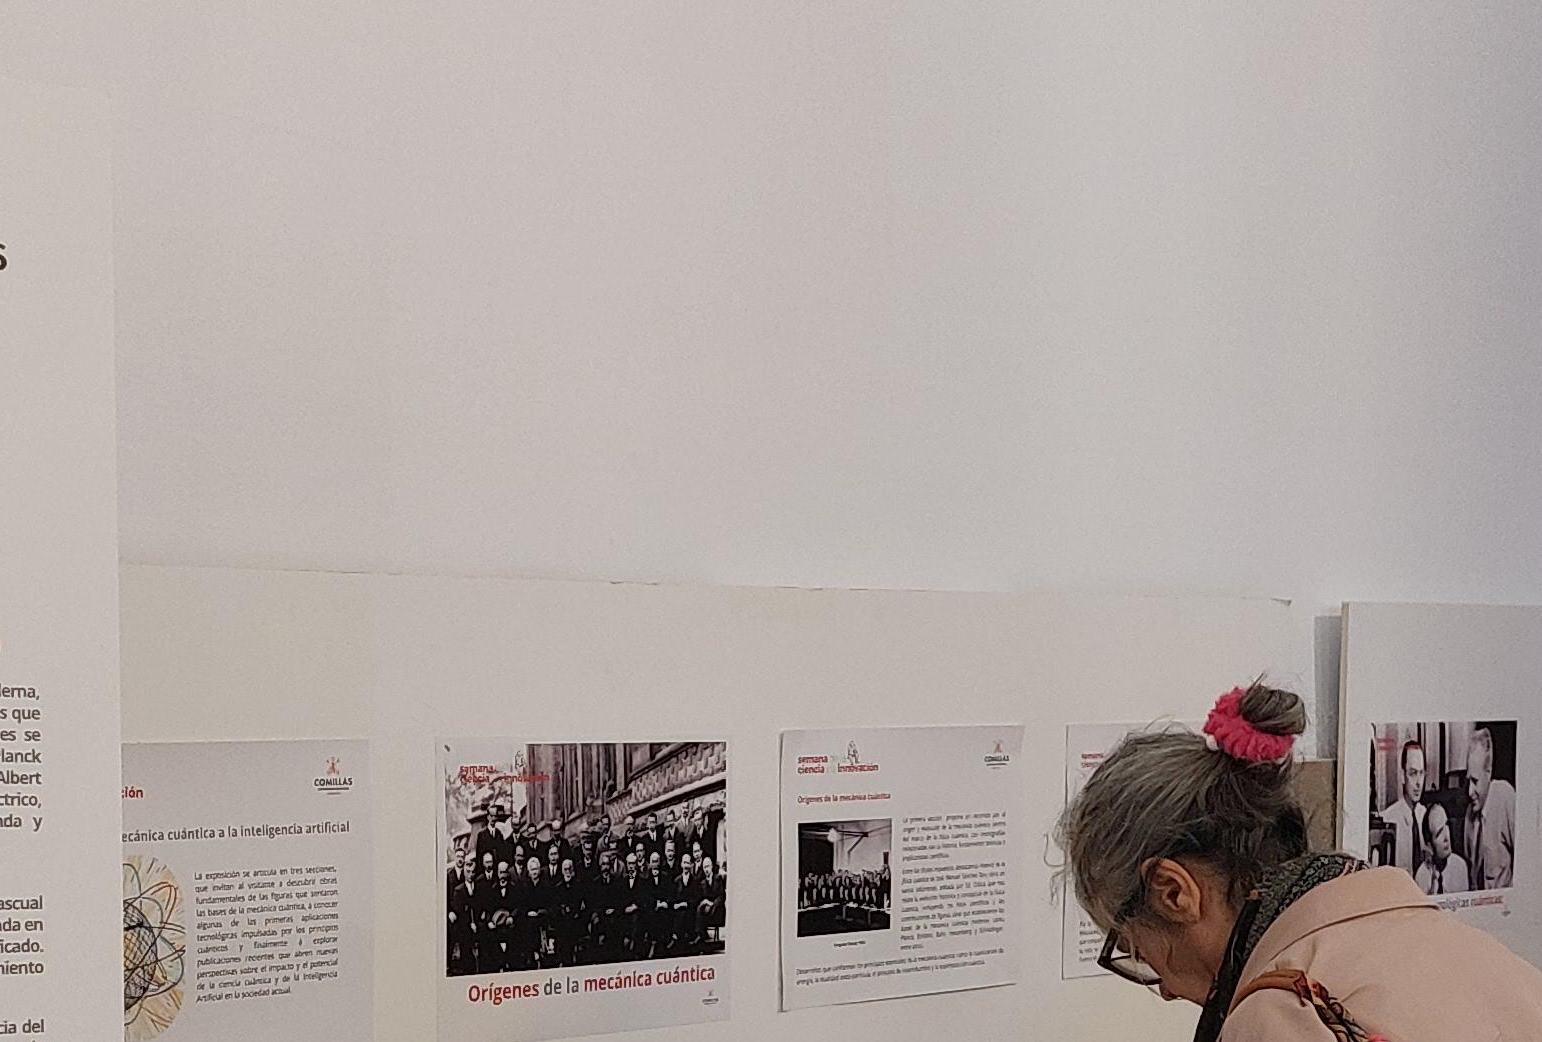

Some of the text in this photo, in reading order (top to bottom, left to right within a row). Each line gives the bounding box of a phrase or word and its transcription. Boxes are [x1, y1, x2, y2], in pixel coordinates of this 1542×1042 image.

[314, 777, 353, 787] COMILLAS
[121, 785, 144, 799] ión
[167, 826, 216, 841] cuántica
[217, 828, 225, 839] a
[227, 825, 238, 838] la
[240, 822, 303, 840] inteligencia
[305, 820, 350, 834] artificial
[468, 966, 715, 1006] Orígenes de la mecánica cuántica
